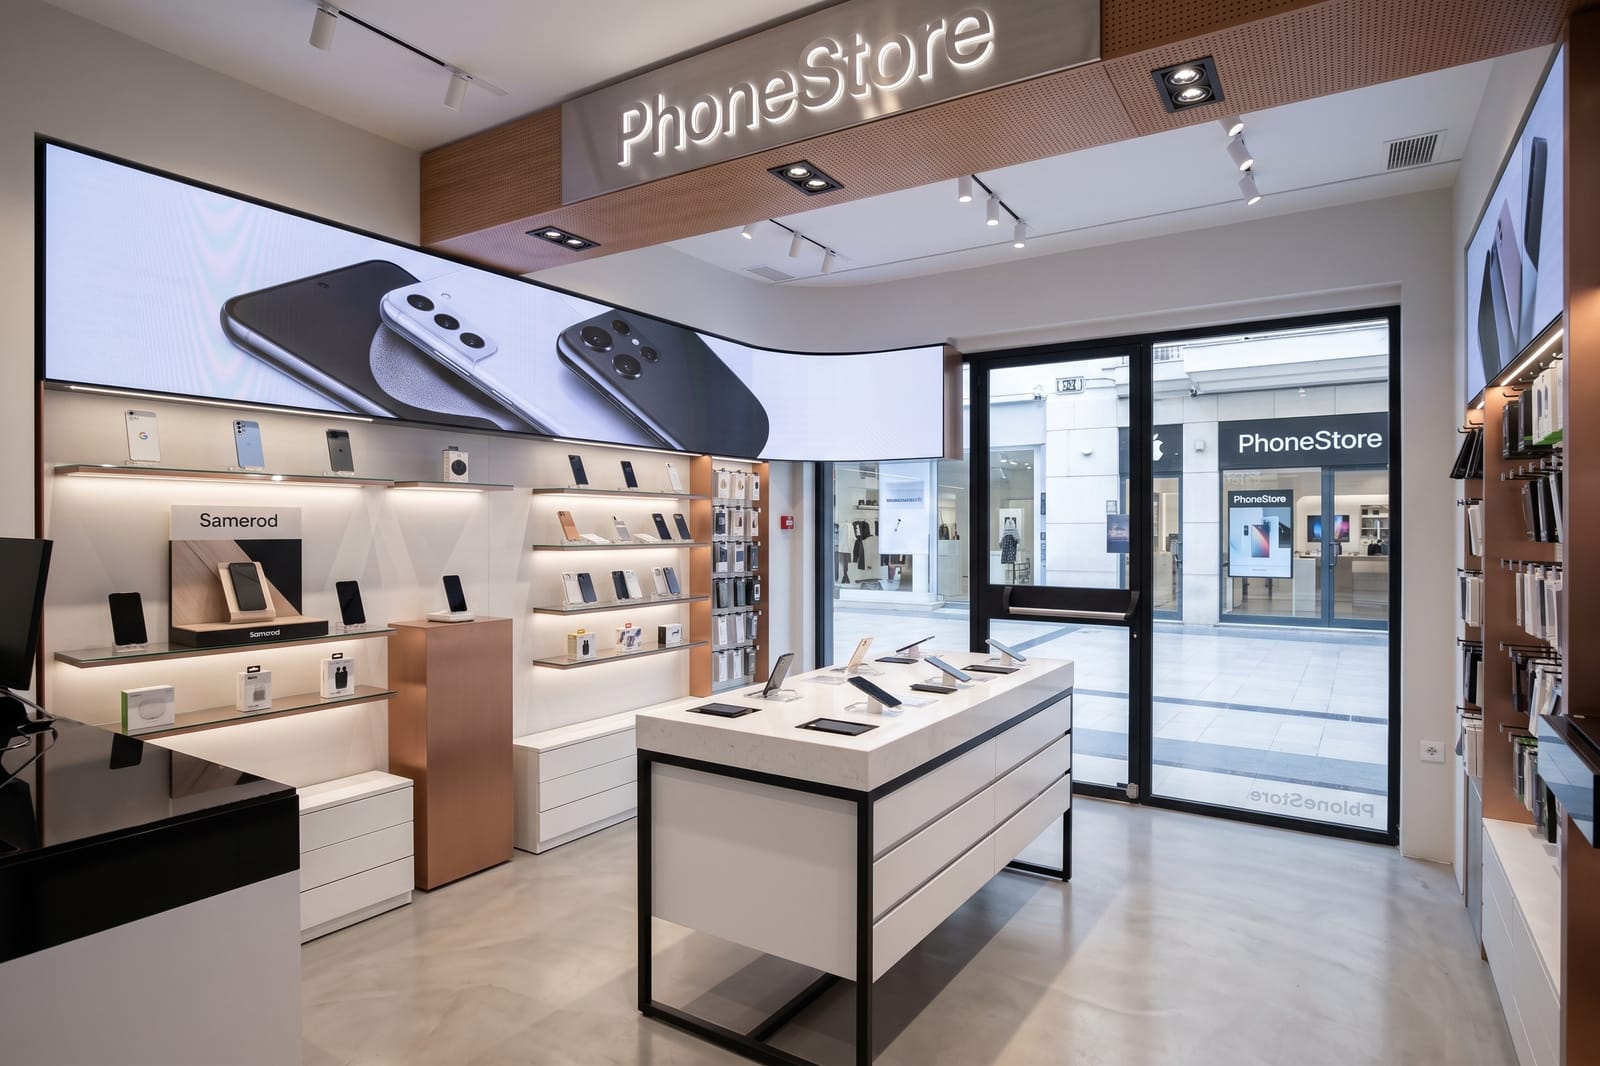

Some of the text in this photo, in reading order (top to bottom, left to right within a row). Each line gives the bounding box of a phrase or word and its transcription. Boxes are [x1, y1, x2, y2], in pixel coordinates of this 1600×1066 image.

[617, 7, 994, 166] PhoneStore
[1238, 430, 1383, 453] PhoneStore
[1233, 494, 1287, 504] PhoneStore
[199, 512, 278, 528] Samerod
